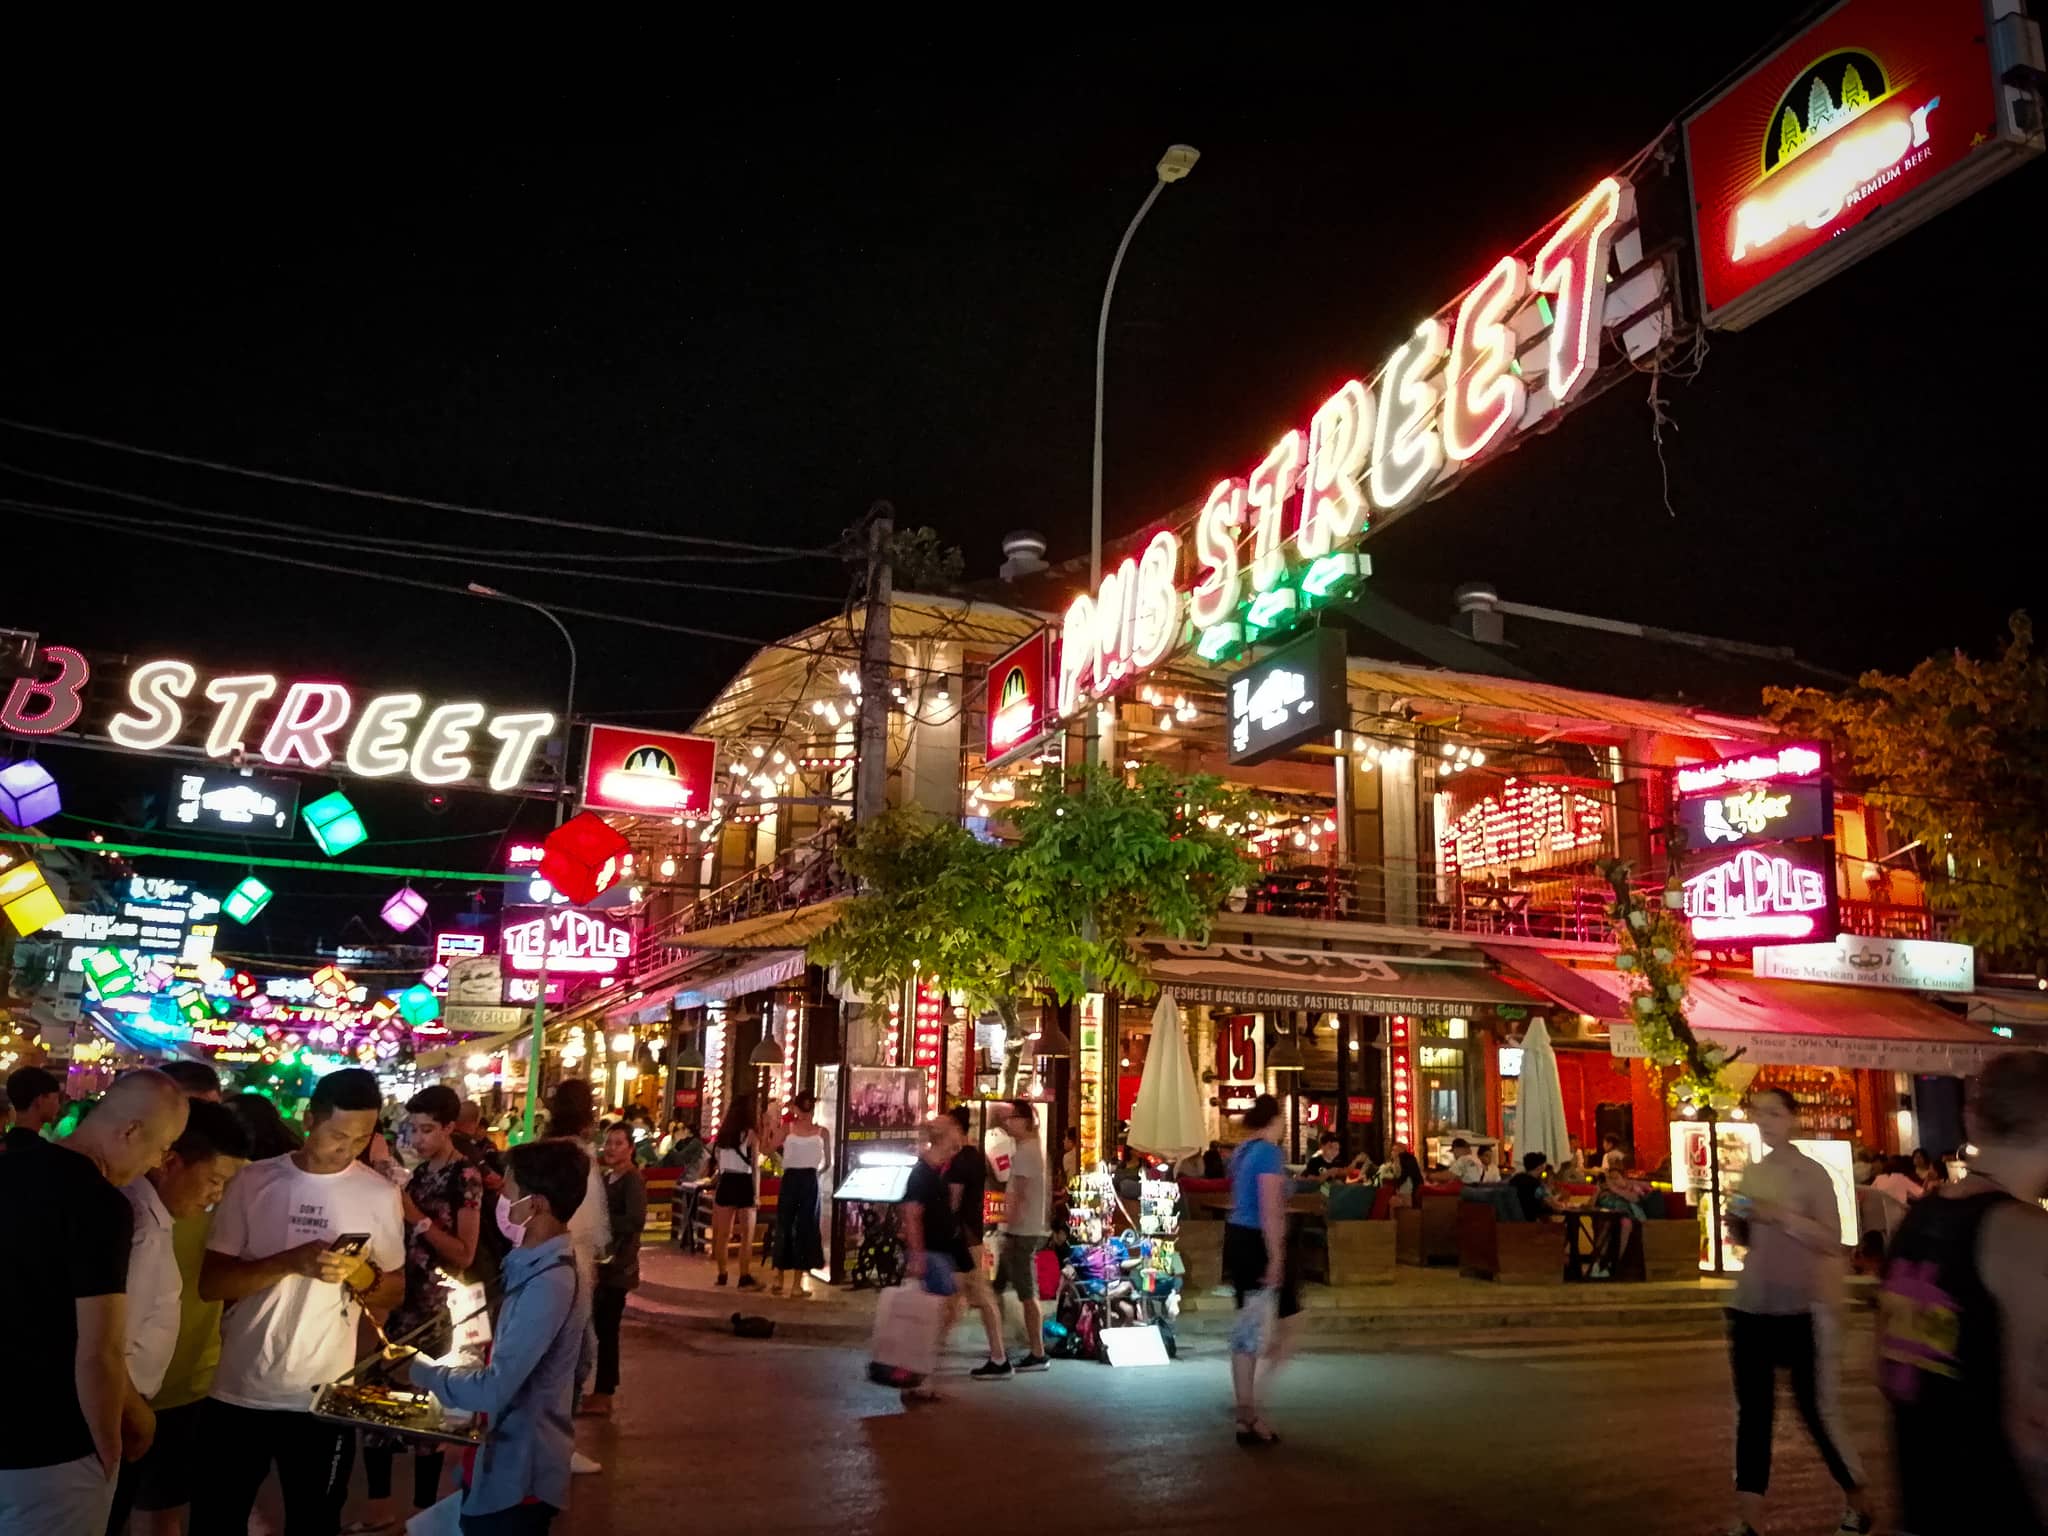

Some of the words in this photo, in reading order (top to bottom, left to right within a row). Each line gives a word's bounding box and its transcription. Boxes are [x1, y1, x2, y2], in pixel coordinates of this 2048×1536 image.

[1846, 166, 1902, 207] PREMIUM
[1904, 147, 1933, 172] BEER
[1190, 175, 1634, 630] STREET
[107, 659, 556, 792] STREET
[1725, 791, 1792, 834] Tiger
[1683, 850, 1828, 918] TEMPLE
[503, 909, 631, 959] TEMPLE
[1161, 984, 1214, 1003] FRESHEST
[1257, 991, 1304, 1010] COOKIES,
[1303, 996, 1350, 1011] PASTRIES
[1351, 998, 1371, 1012] AND
[1373, 999, 1424, 1014] HOMEMADE
[1425, 1002, 1441, 1016] ICE
[1442, 1003, 1474, 1018] CREAM
[1802, 965, 1855, 982] Mexican
[1856, 969, 1879, 983] and
[1880, 971, 1921, 987] Khmer
